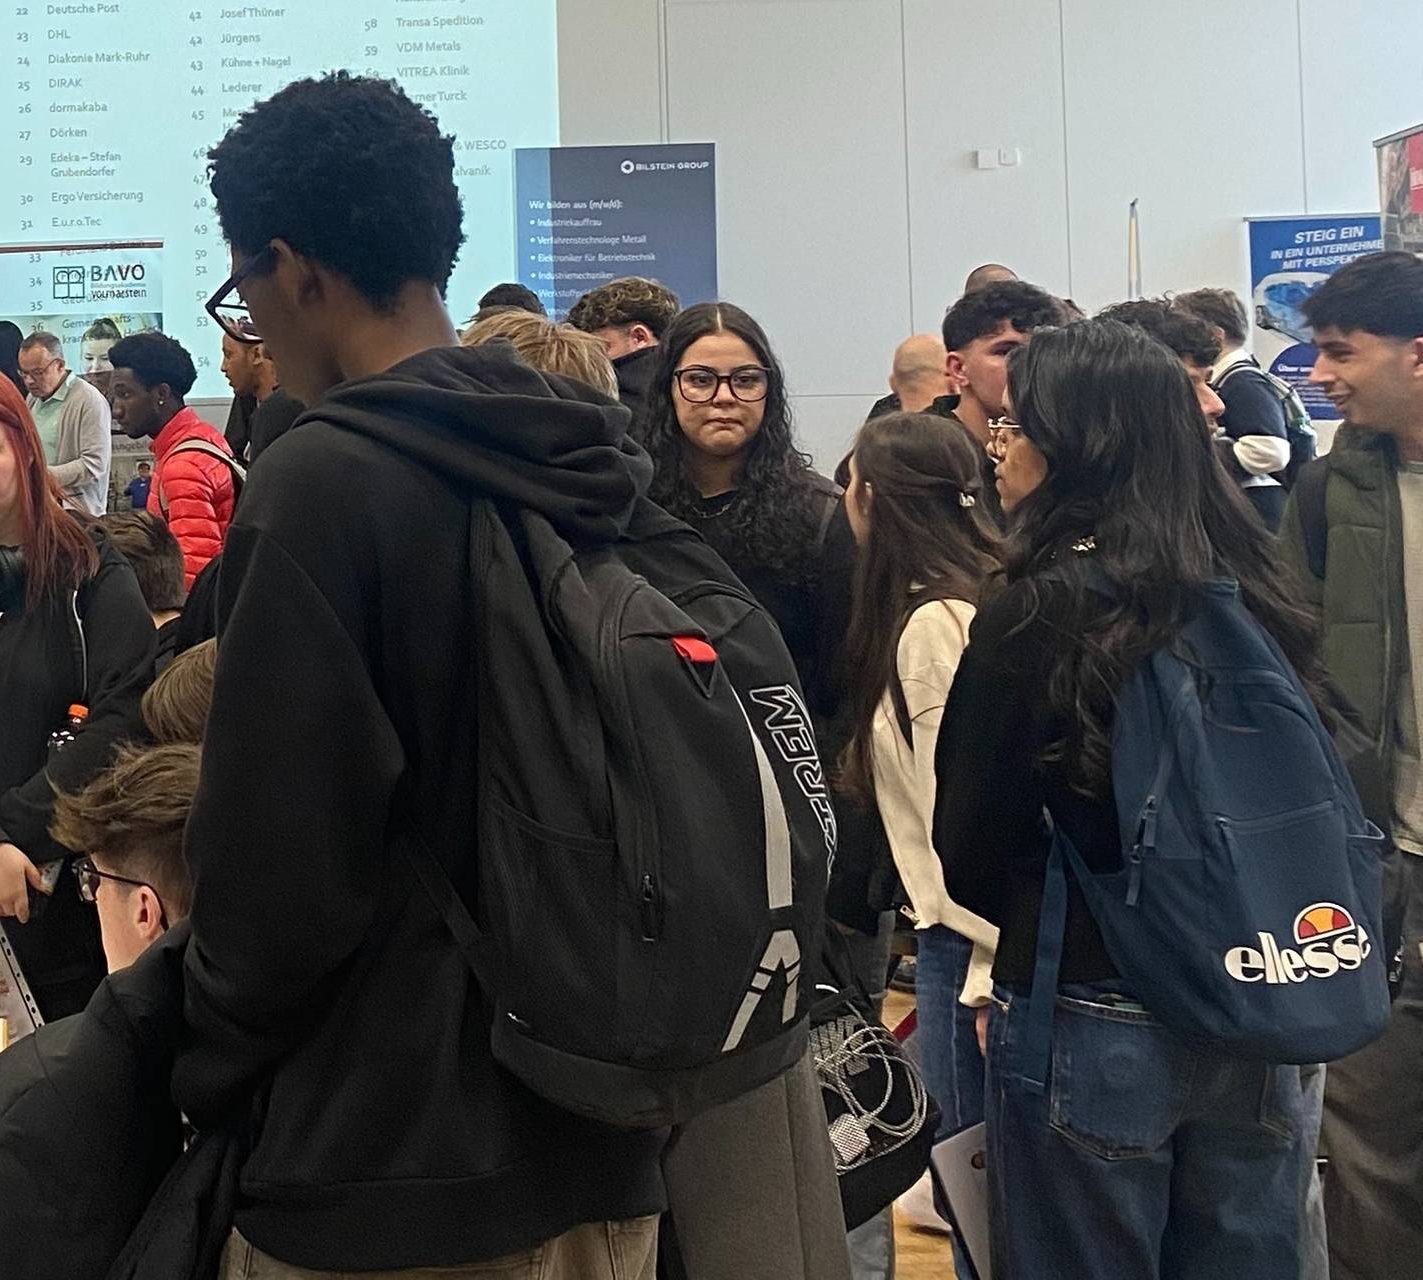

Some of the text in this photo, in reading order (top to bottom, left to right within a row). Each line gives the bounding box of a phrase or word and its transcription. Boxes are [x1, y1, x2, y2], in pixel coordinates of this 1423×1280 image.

[16, 7, 29, 16] 22
[47, 3, 120, 15] Deutsche Post
[220, 7, 285, 18] Josef Thüner
[365, 19, 377, 31] 58
[396, 15, 483, 29] Transa Spedition
[17, 32, 29, 43] 23
[47, 29, 71, 40] DHL
[220, 32, 261, 46] Jürgens
[190, 35, 203, 46] 42
[365, 45, 378, 57] 59
[396, 41, 461, 53] VDM Metals
[17, 56, 30, 68] 24
[48, 51, 151, 64] Diakonie Mark-Ruhr
[221, 55, 291, 69] Kühne Nagel
[190, 60, 203, 72] 43
[397, 65, 470, 77] VITREA Klinik
[18, 81, 31, 92] 25
[49, 78, 82, 89] DIRAK
[222, 82, 263, 93] Lederer
[191, 84, 204, 96] 44
[437, 91, 467, 102] Turck
[18, 103, 31, 115] 26
[49, 102, 108, 113] dormakaba
[192, 109, 205, 121] 45
[19, 130, 31, 141] 27
[50, 127, 87, 139] Dörken
[464, 140, 507, 151] WESCO
[19, 155, 32, 166] 29
[50, 151, 121, 163] Edeka Stefan
[454, 166, 491, 176] alvanik
[636, 161, 709, 171] BILSTEIN GROUP
[51, 167, 116, 179] Grubendorfer
[20, 193, 33, 205] 30
[52, 190, 143, 204] Ergo Versicherung
[194, 198, 207, 209] 48
[529, 201, 544, 209] Wir
[547, 200, 571, 210] bilden
[573, 202, 587, 210] aus
[52, 217, 102, 228] E.u.r.o.Tec
[537, 218, 602, 227] Industriekauffrau
[194, 224, 207, 235] 49
[1295, 226, 1364, 244] STEIG EIN
[622, 235, 646, 244] Metall
[1271, 239, 1384, 259] IN EIN UNTERNEHME
[29, 252, 42, 264] 33
[195, 251, 207, 261] 50
[1283, 255, 1354, 270] MIT PERSPEK
[90, 264, 145, 282] BAVO
[30, 277, 42, 288] 34
[196, 290, 208, 300] 52
[30, 301, 43, 312] 35
[197, 317, 208, 328] 53
[198, 357, 209, 368] 54
